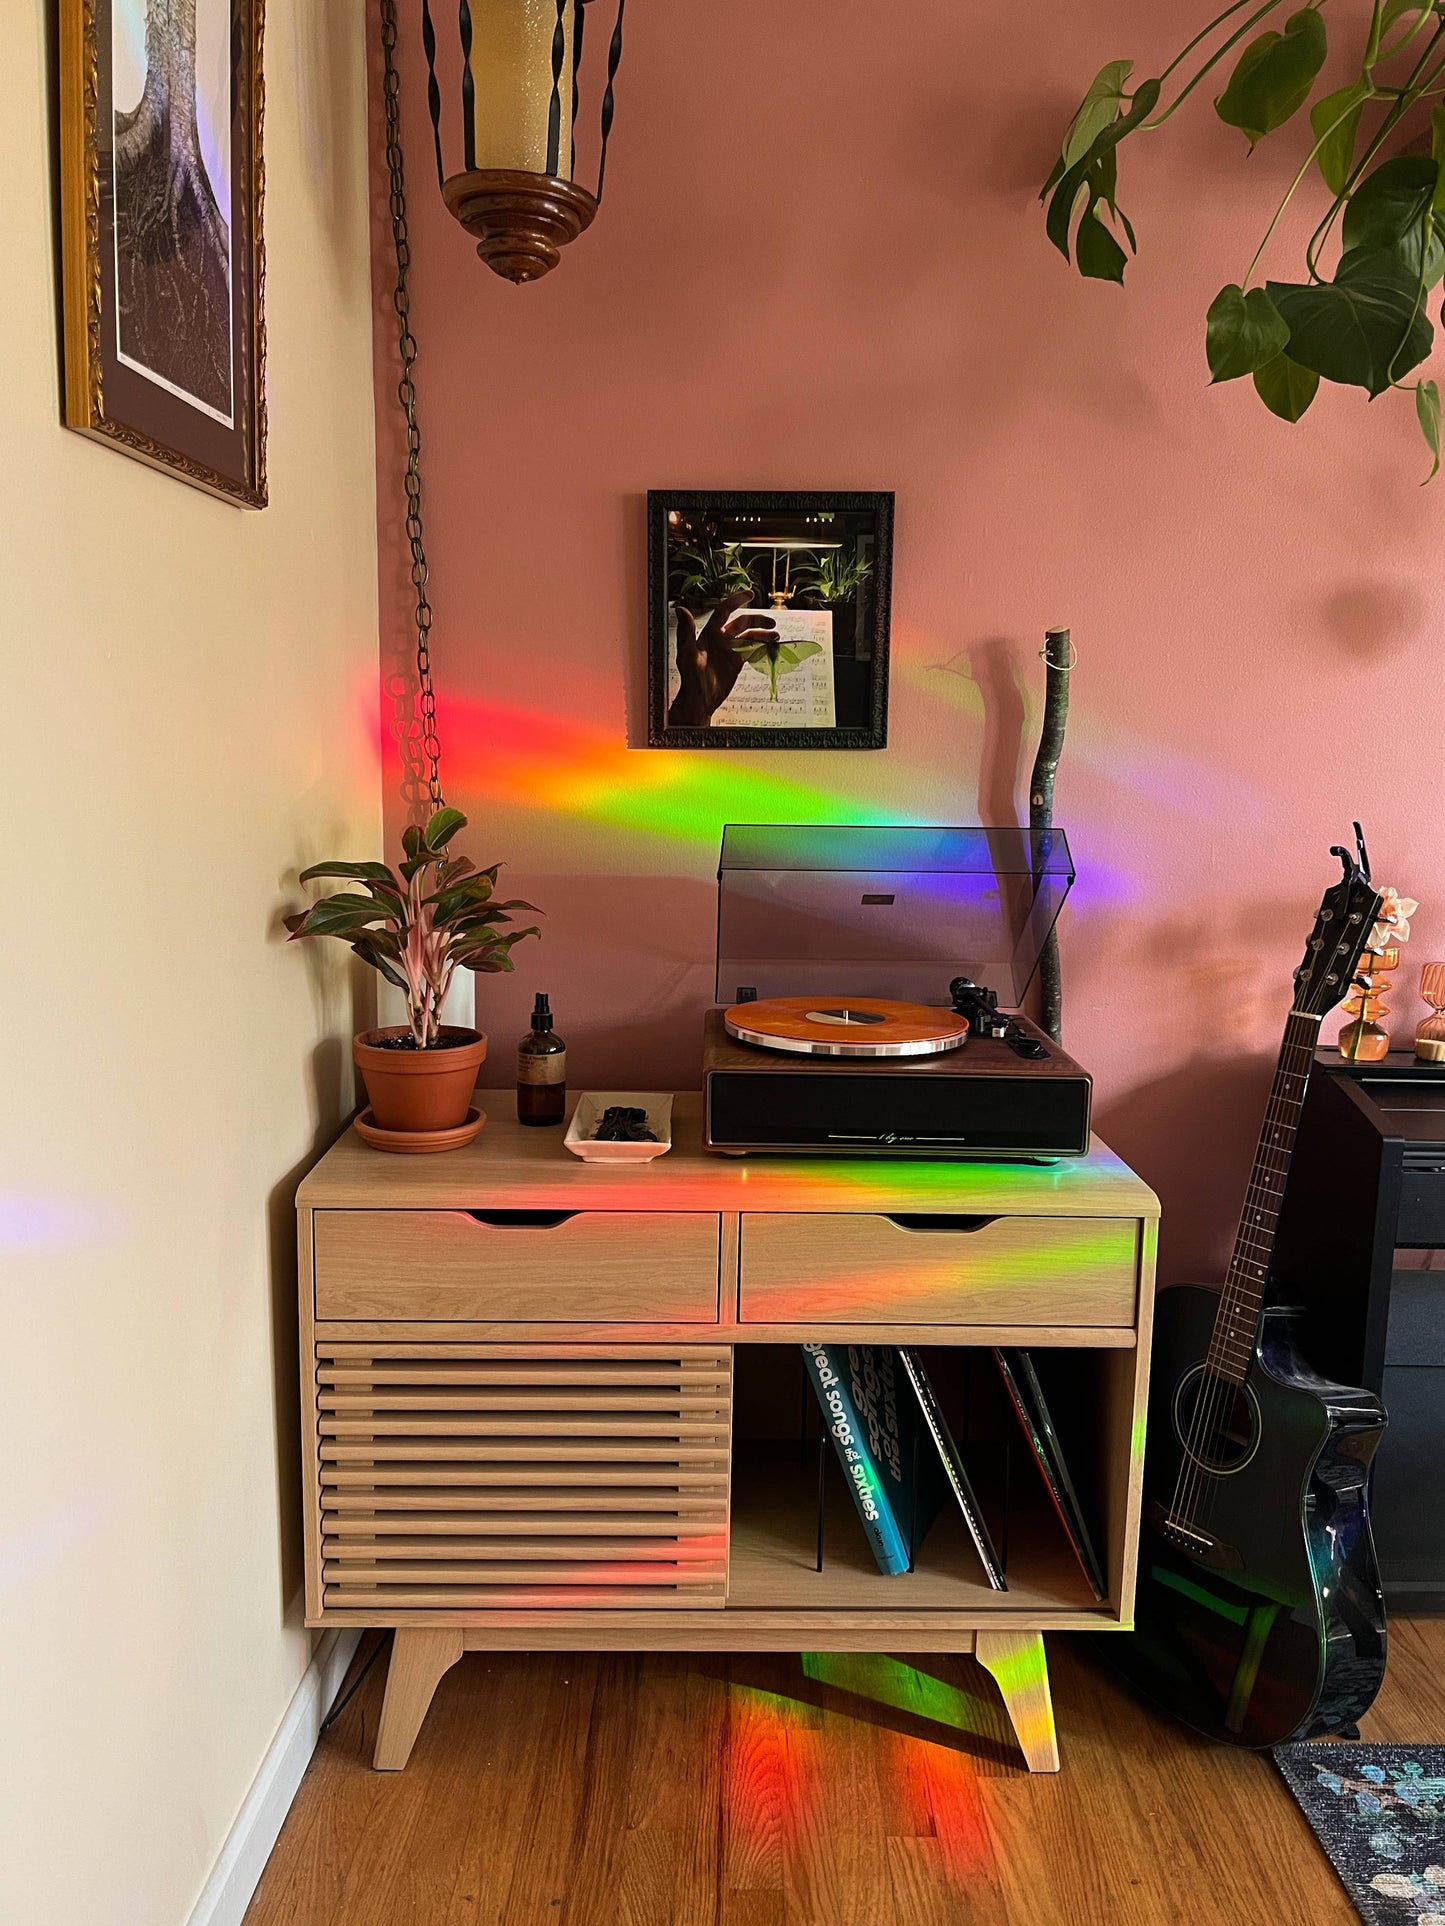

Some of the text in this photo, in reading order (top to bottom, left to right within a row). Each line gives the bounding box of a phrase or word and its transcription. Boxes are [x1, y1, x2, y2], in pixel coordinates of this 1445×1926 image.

[826, 1390, 855, 1446] songs
[878, 1344, 899, 1439] sixtie
[844, 1447, 854, 1462] the
[851, 1451, 862, 1461] of
[850, 1463, 879, 1521] sixties
